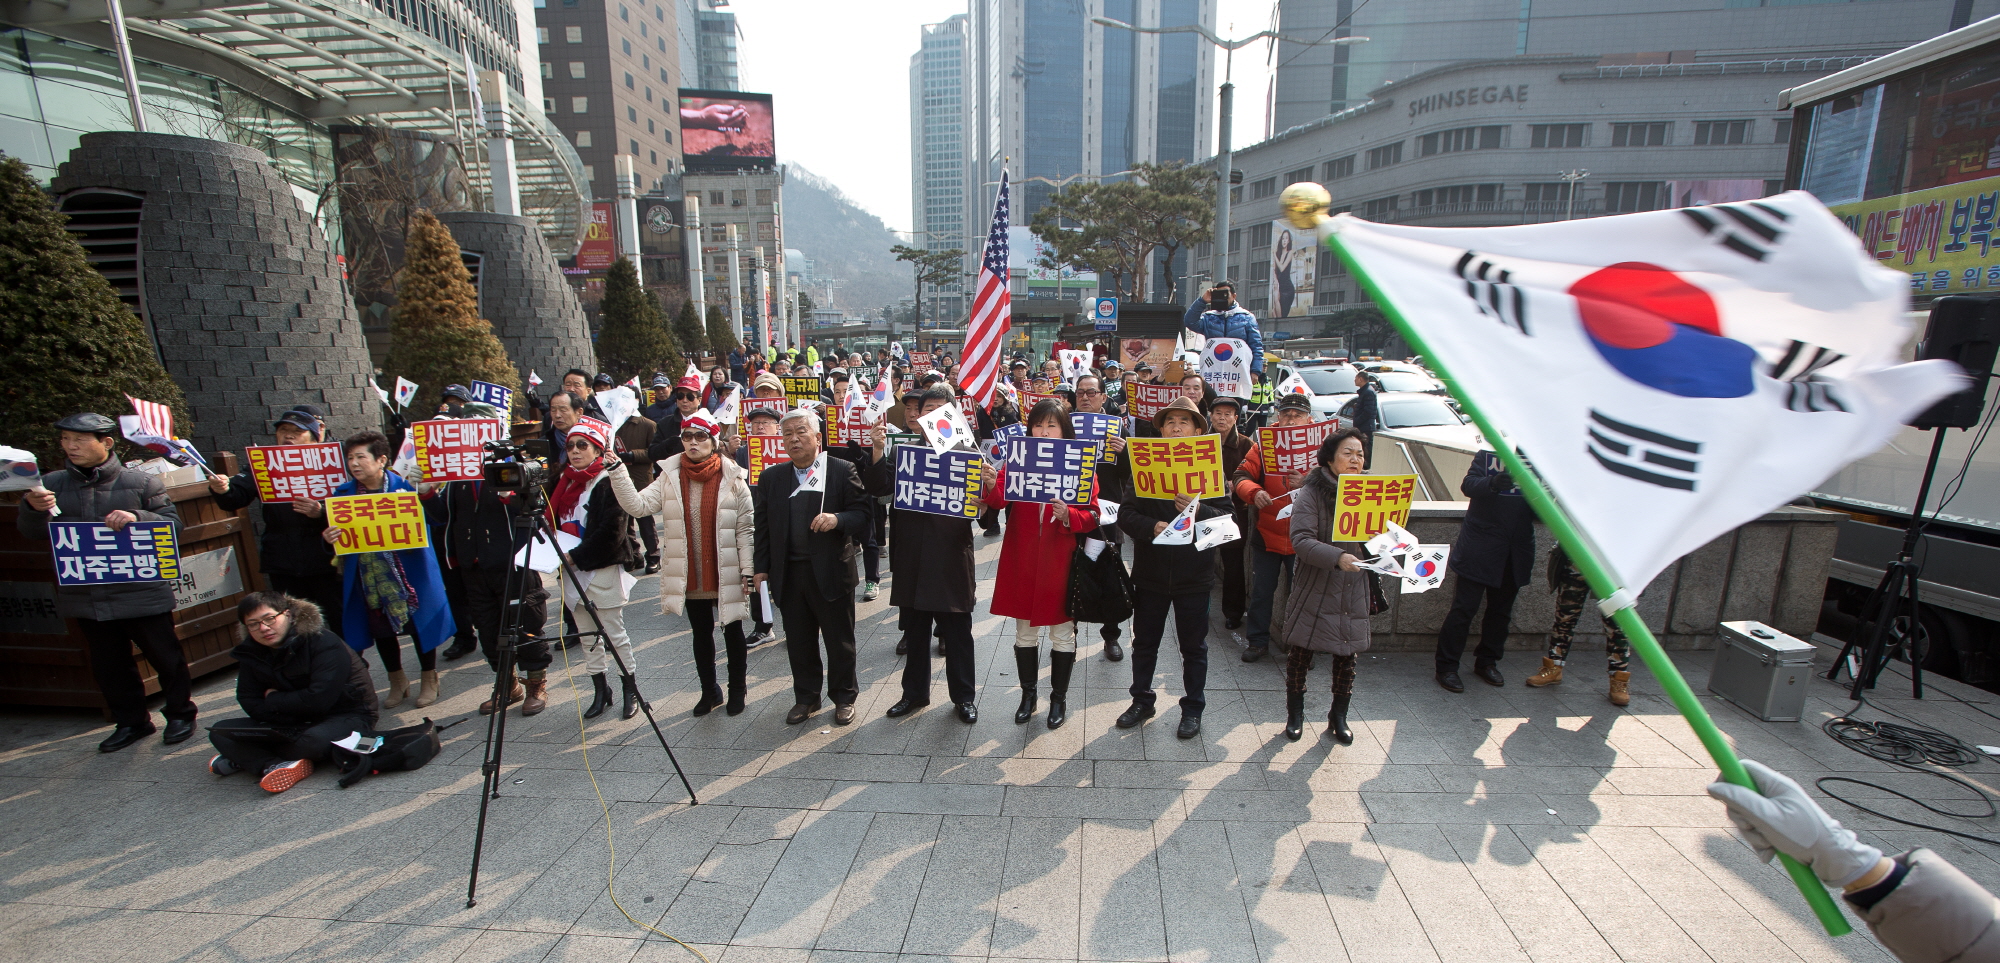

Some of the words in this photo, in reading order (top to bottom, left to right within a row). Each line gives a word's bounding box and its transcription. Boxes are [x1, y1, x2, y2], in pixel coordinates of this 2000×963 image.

[1408, 84, 1529, 118] SHINSEGAE
[583, 215, 607, 224] SALE
[1943, 190, 2000, 258] 보복
[1127, 383, 1137, 416] THAAD
[1137, 404, 1164, 419] 보복
[427, 423, 497, 449] 사드배치
[827, 406, 838, 445] THAAD
[838, 428, 874, 446] 보복중
[1274, 420, 1338, 449] 사드배치
[267, 446, 342, 472] 사드배치
[413, 425, 432, 479] THAAD
[750, 437, 763, 484] THAAD
[1131, 439, 1217, 467] 중국속국
[1260, 429, 1278, 473] THAAD
[1276, 451, 1319, 473] 보복중
[250, 449, 276, 501] THAAD
[272, 473, 346, 499] 보복중단
[964, 458, 983, 517] THAAD
[1006, 471, 1079, 502] 자주국방
[1076, 445, 1097, 503] THAAD
[1136, 470, 1220, 495] 아니다!
[896, 479, 965, 514] 자주국방
[1342, 478, 1414, 507] 중국속국
[332, 495, 419, 524] 중국속국
[338, 522, 424, 549] 아니다!
[153, 524, 179, 579] THAAD
[59, 554, 158, 582] 자주국방
[193, 588, 217, 602] Tower
